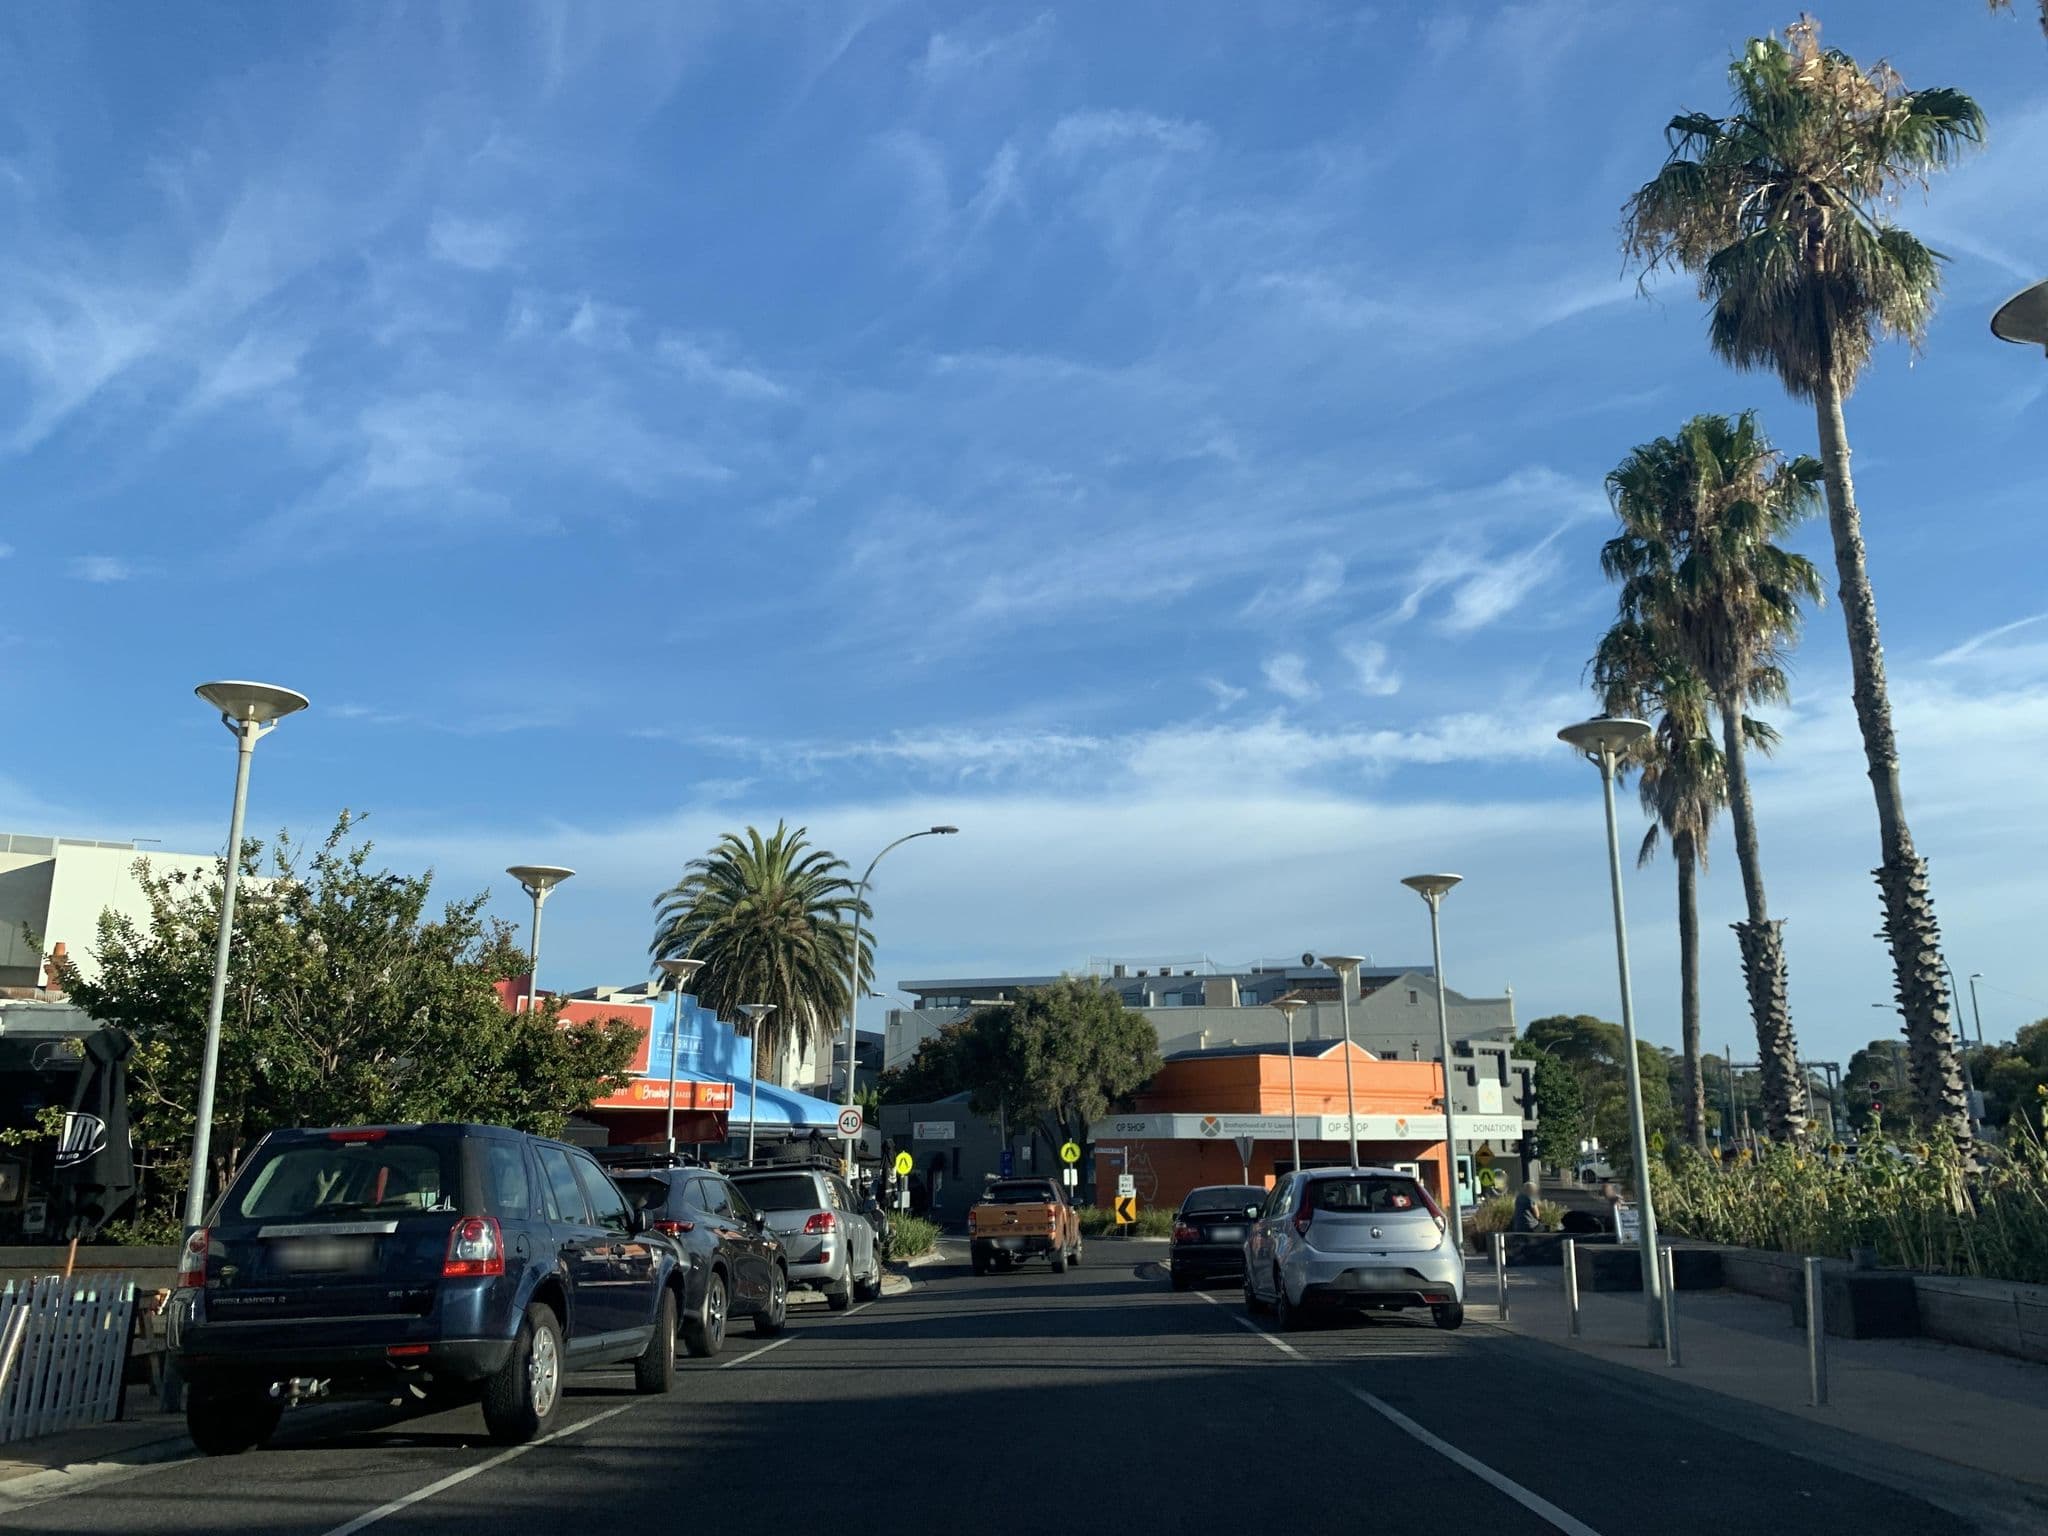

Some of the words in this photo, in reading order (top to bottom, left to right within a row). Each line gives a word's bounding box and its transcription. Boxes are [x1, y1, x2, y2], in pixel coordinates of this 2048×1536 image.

[842, 1116, 858, 1128] 40
[1116, 1123, 1126, 1132] OP
[1127, 1122, 1145, 1132] SHOP
[1328, 1122, 1341, 1132] OP
[1343, 1122, 1369, 1132] SOP
[1473, 1123, 1517, 1133] DONATIONS
